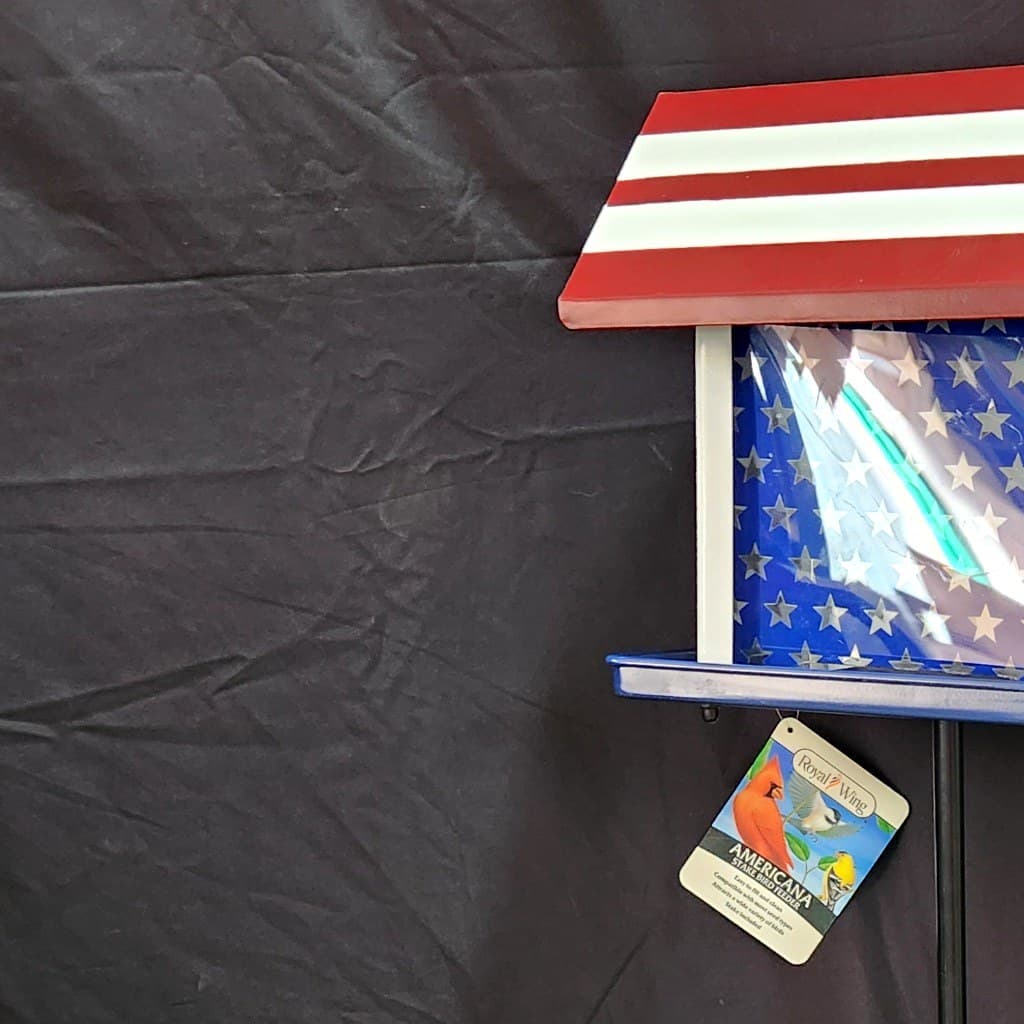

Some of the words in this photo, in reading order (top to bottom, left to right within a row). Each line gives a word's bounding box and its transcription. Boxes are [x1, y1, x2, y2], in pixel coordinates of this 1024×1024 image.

[798, 755, 832, 785] Royal
[840, 782, 868, 815] Wing
[729, 843, 812, 908] AMERICANA
[731, 857, 756, 878] STAKE
[756, 873, 775, 889] BIRD
[774, 886, 801, 910] FEEDER
